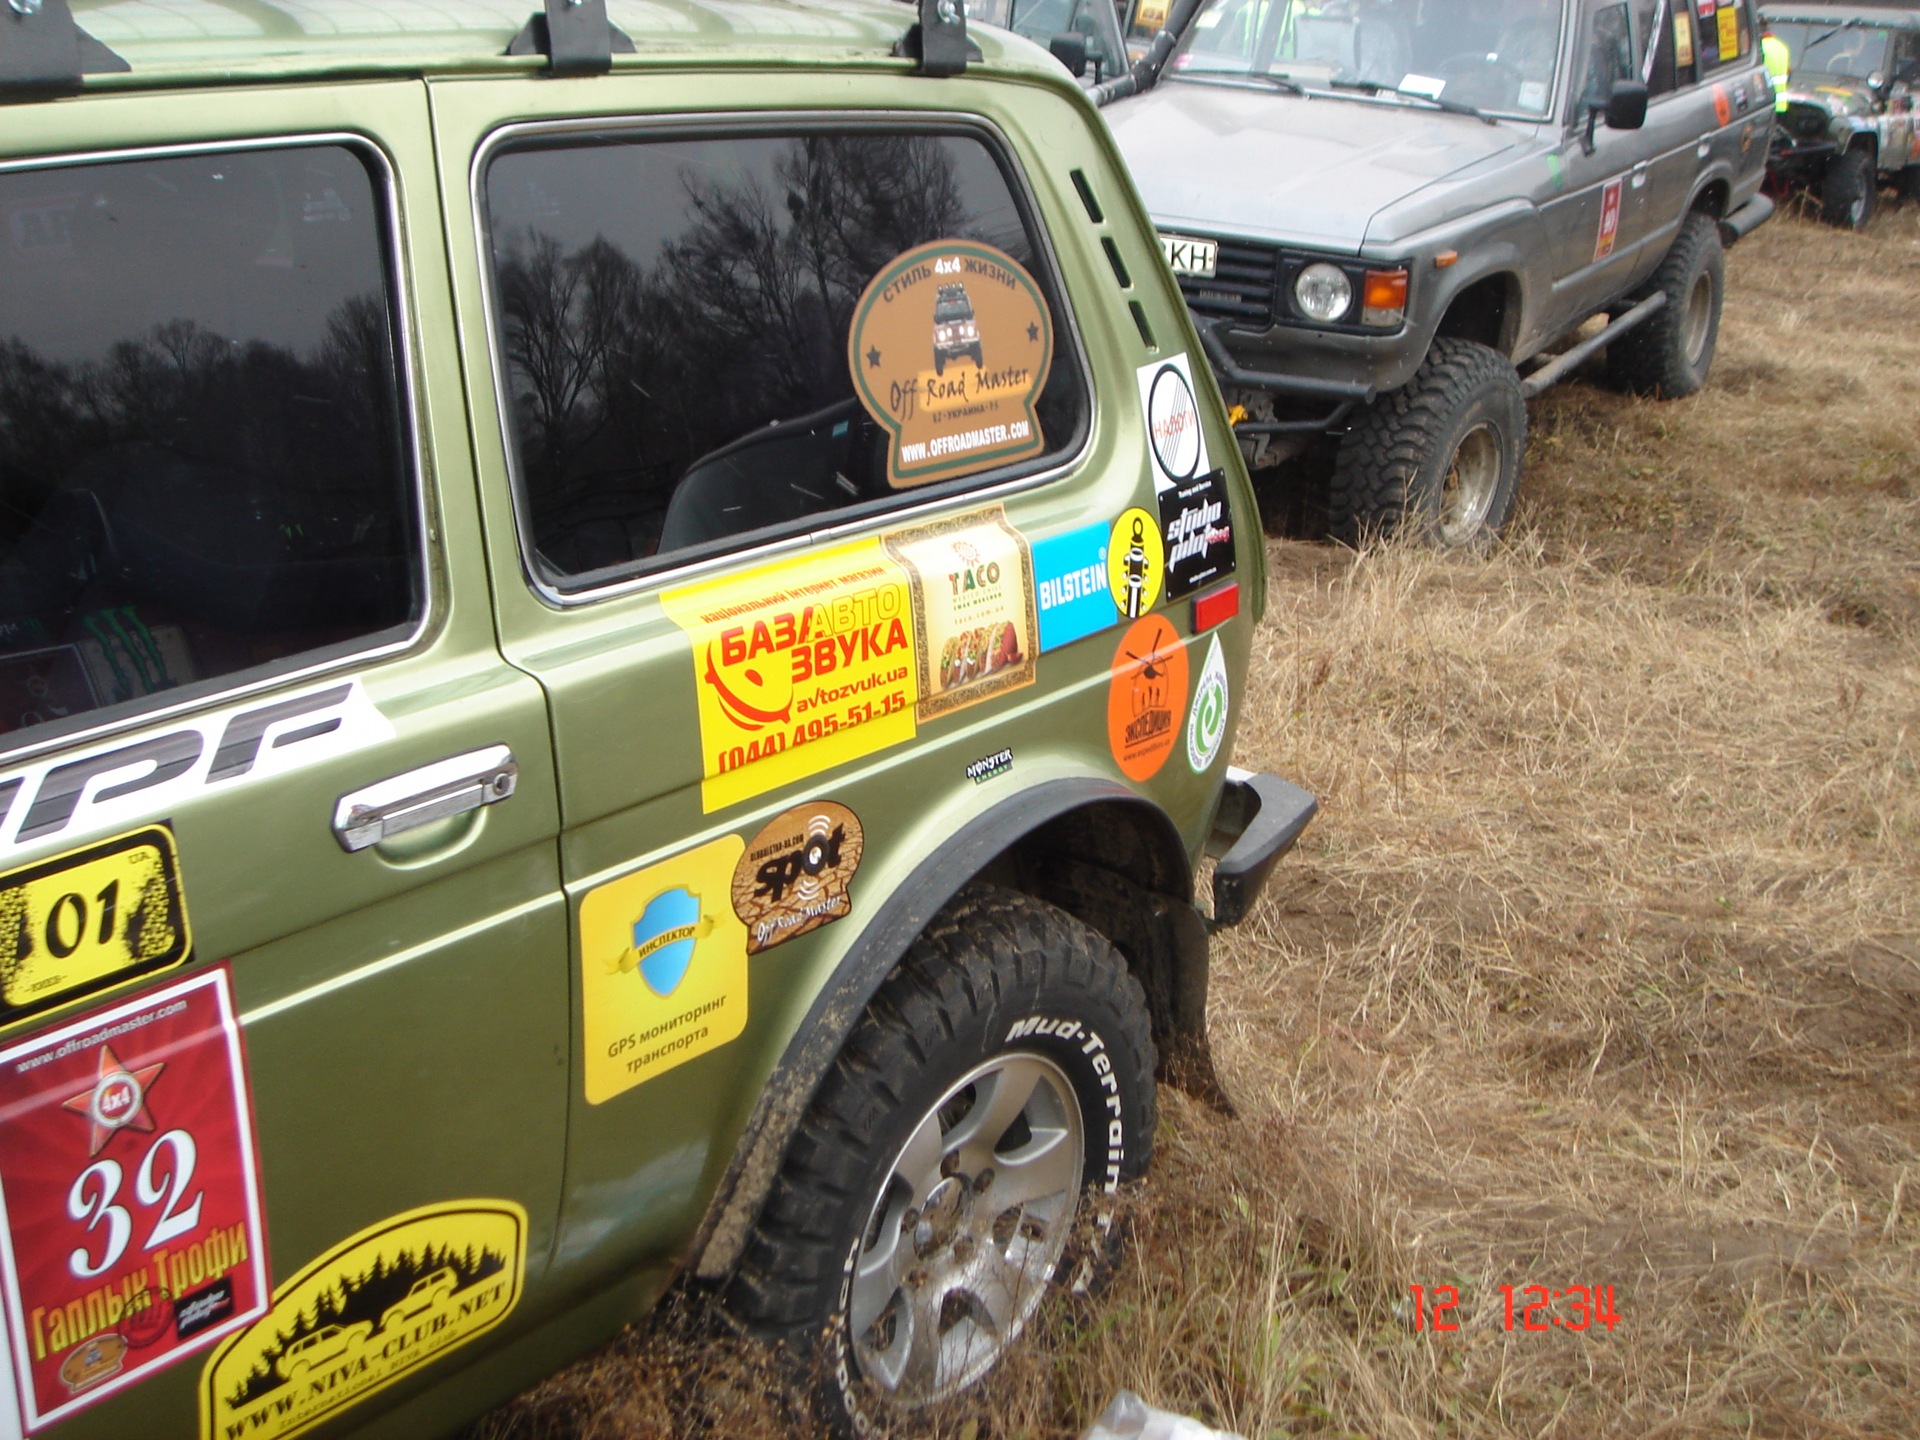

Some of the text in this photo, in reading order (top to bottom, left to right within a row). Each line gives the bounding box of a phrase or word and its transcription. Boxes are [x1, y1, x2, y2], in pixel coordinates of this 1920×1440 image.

[883, 256, 1017, 303] СТИЛЬ 4x4 ЖИЗНИ
[1161, 241, 1208, 272] KH
[890, 367, 1029, 421] Off Road Master
[901, 420, 1030, 463] WWW.OFFROADMASTER.COM
[948, 561, 1000, 596] TACO
[1039, 561, 1107, 611] BILSTEIN
[806, 583, 901, 644] АВТО
[791, 617, 909, 684] ЗВУКА
[796, 666, 909, 714] avtozvuk.ua
[718, 690, 907, 774] (044) 495-51-15
[966, 748, 1013, 778] MONSTER
[45, 878, 120, 959] 01
[637, 925, 697, 959] ИНСПЕКТОР
[16, 999, 188, 1073] www.offroadmaster.com
[608, 995, 728, 1060] GPS мониторинг
[626, 1025, 710, 1074] транспорта
[101, 1085, 132, 1113] 4x4
[1003, 1013, 1126, 1195] Mud-Terrain
[67, 1128, 204, 1278] 32
[152, 1221, 249, 1301] Трофи
[225, 1280, 507, 1440] WWW.NIVA-CLUB.NET
